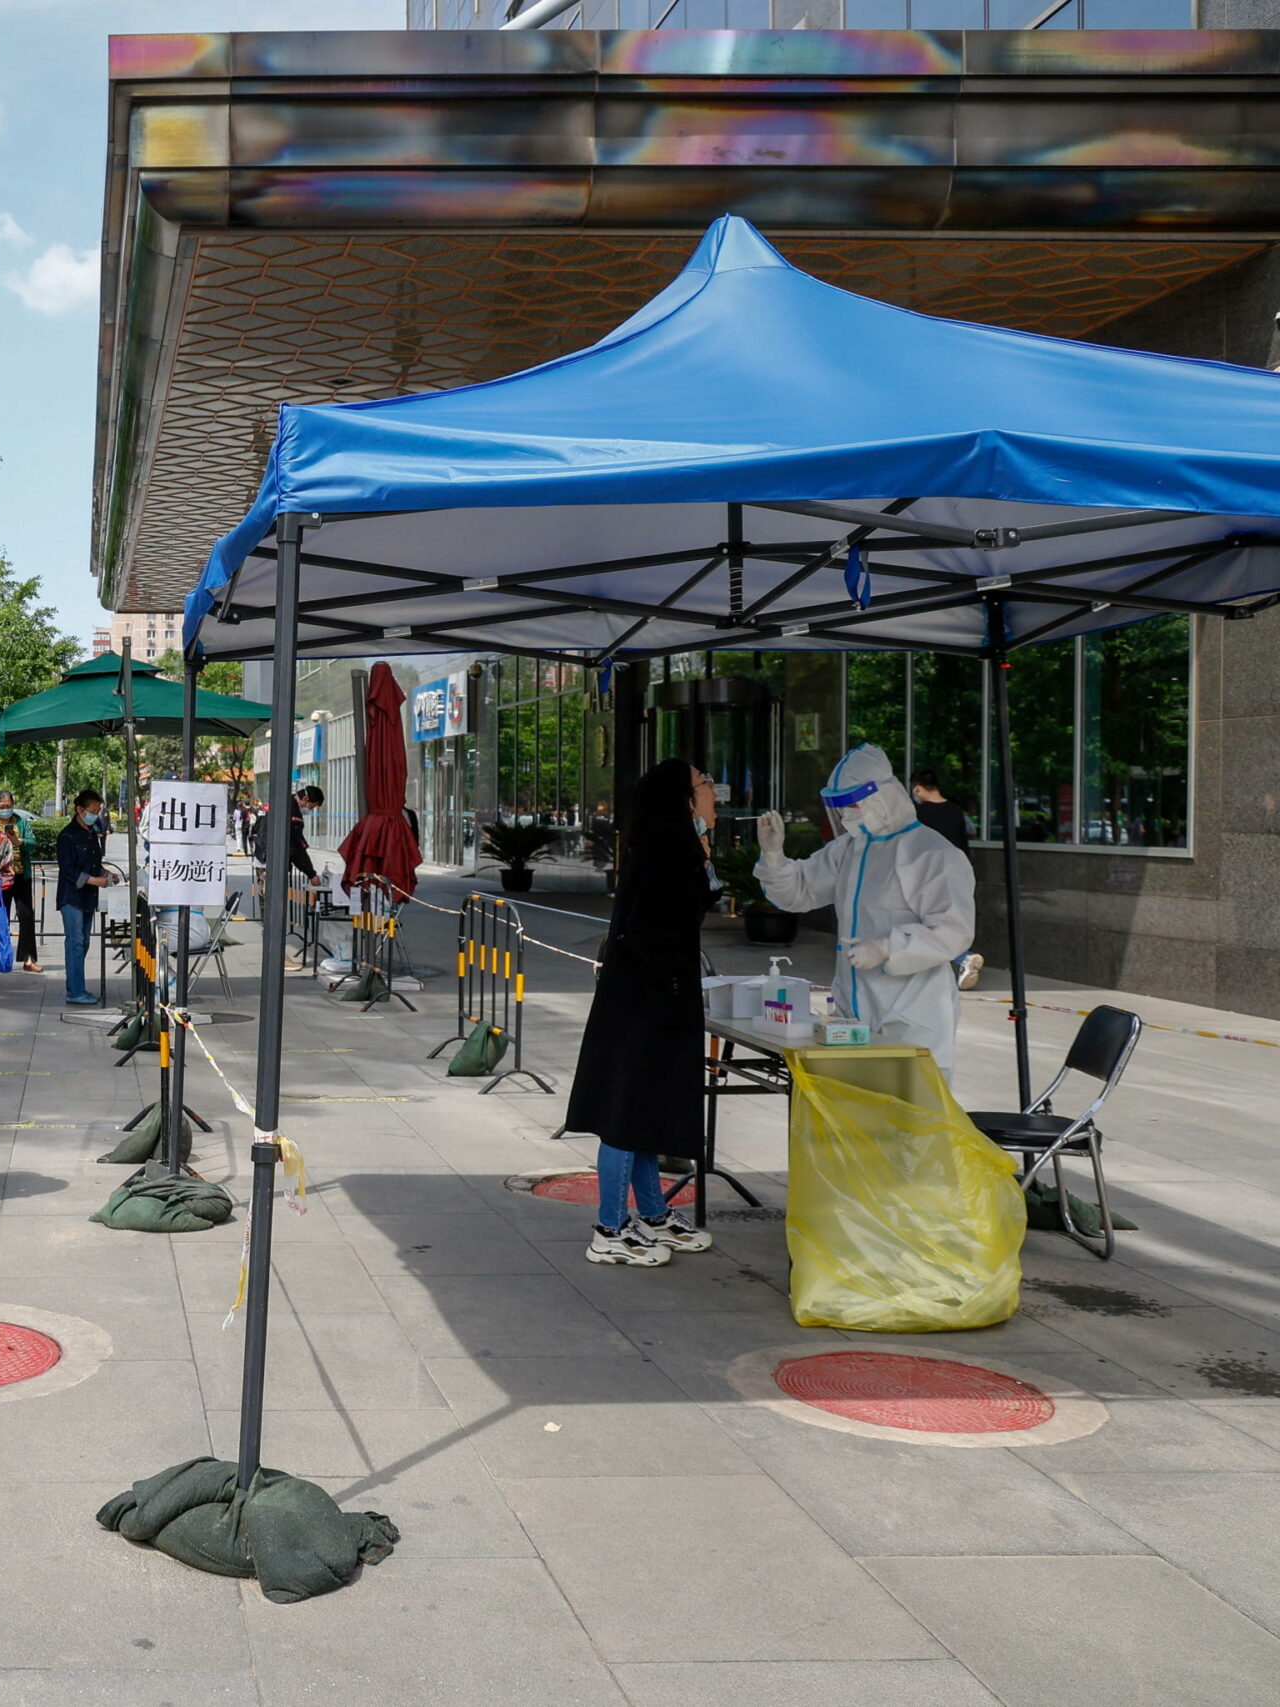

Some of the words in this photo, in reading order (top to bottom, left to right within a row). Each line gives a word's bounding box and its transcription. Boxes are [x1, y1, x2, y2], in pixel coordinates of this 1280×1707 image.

[158, 797, 217, 832] 出口
[152, 859, 225, 883] 请勿逆行
